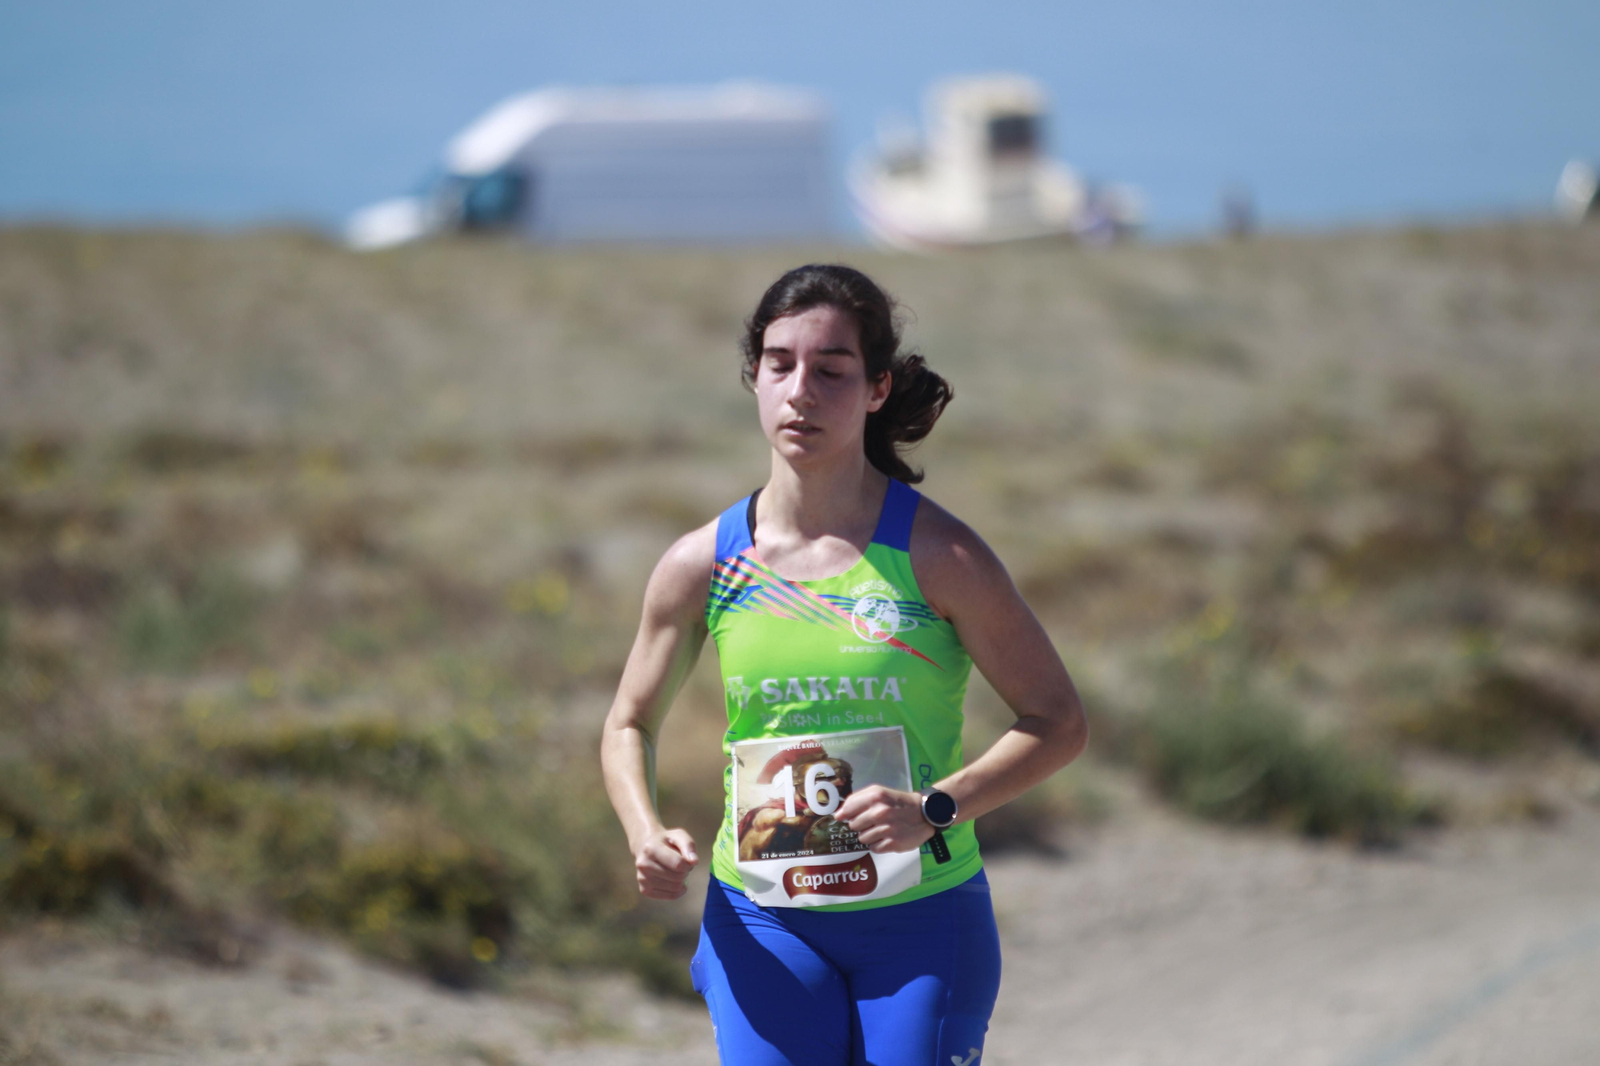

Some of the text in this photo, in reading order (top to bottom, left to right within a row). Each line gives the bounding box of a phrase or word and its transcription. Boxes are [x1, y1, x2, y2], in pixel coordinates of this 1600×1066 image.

[760, 676, 903, 704] SAKATA
[827, 713, 841, 725] in
[772, 763, 840, 818] 16
